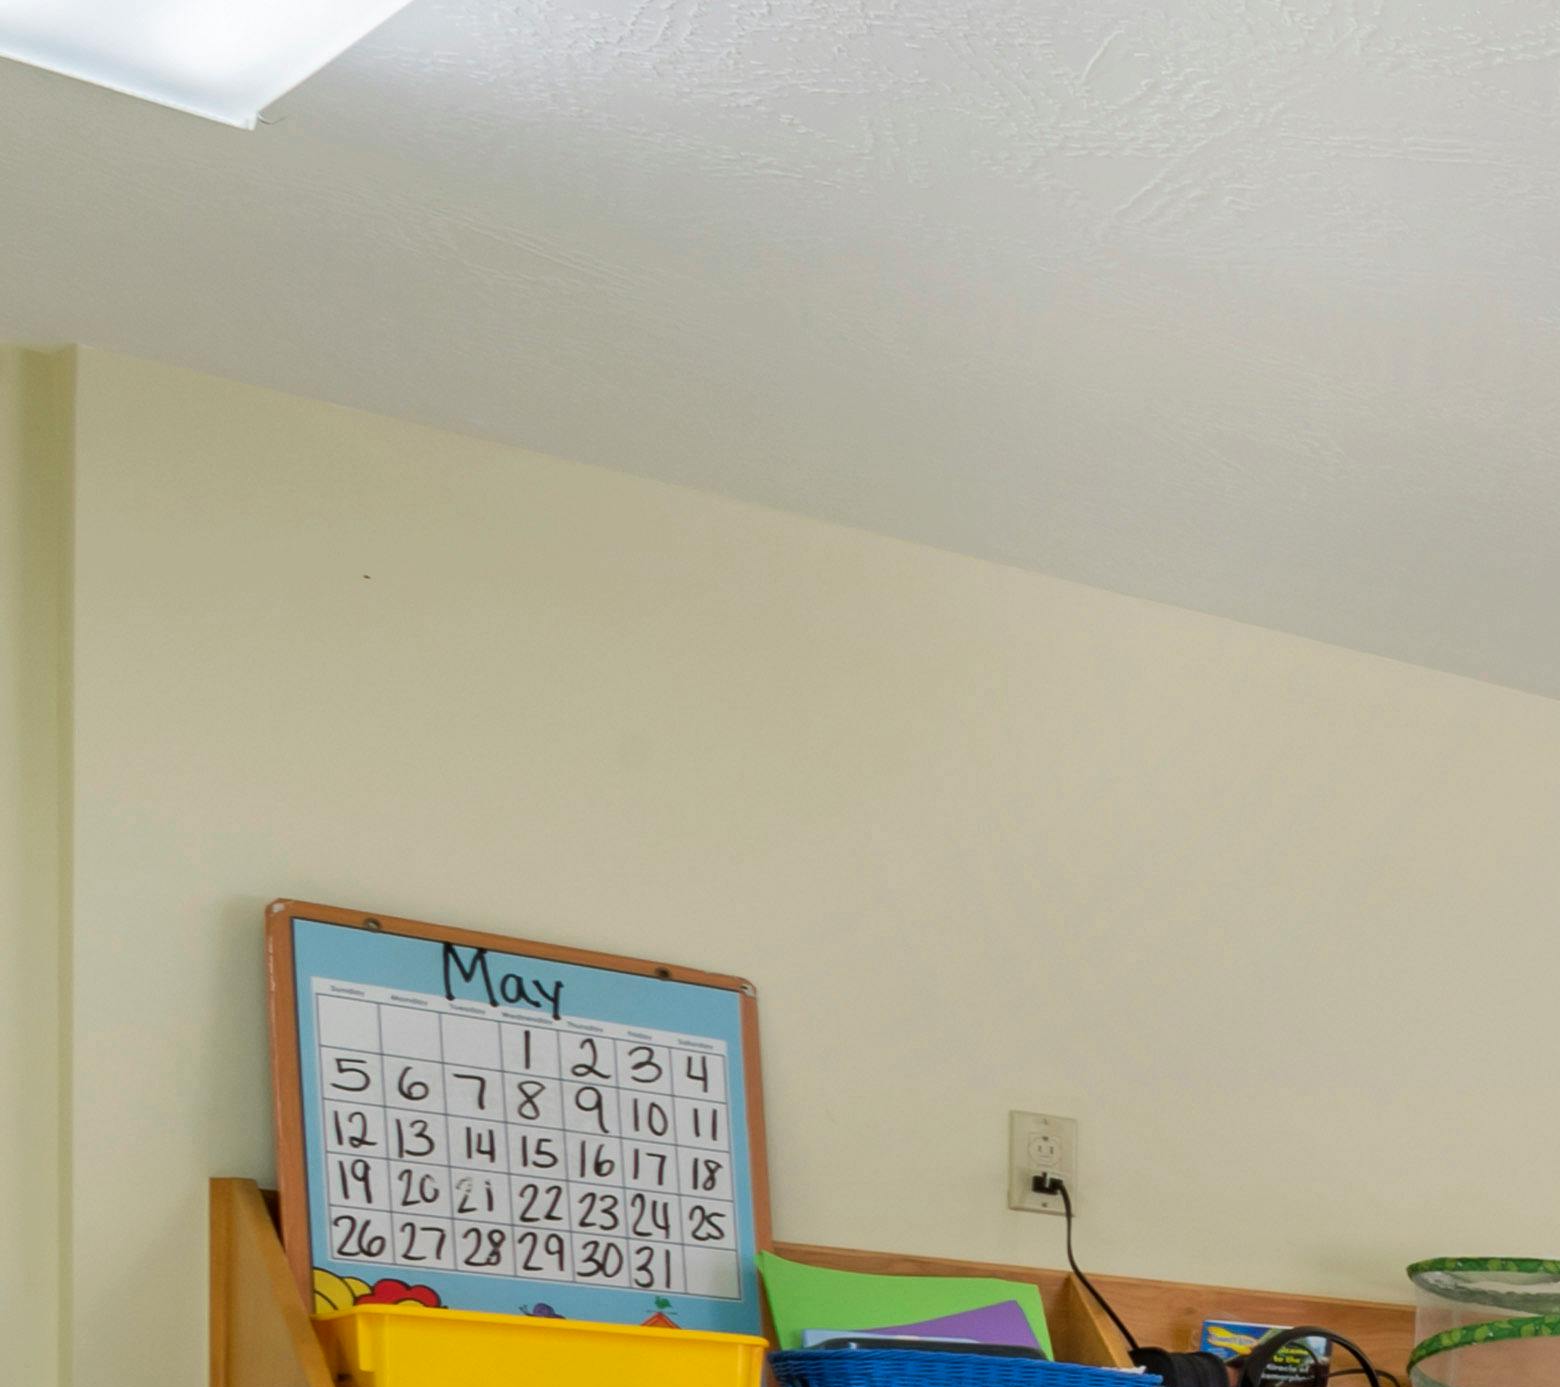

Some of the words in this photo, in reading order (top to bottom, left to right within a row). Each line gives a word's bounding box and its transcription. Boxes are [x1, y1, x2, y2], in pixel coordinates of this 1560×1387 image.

[443, 942, 563, 1020] May
[329, 1057, 372, 1093] 5
[397, 1065, 430, 1102] 6
[451, 1072, 488, 1112] 7
[516, 1079, 547, 1122] 8
[574, 1085, 611, 1135] 9
[632, 1097, 670, 1138] 10
[692, 1107, 719, 1142] 11
[523, 1029, 531, 1070] 1
[570, 1037, 612, 1080] 2
[627, 1045, 664, 1084] 3
[685, 1055, 709, 1094] 4
[333, 1109, 379, 1150] 12
[395, 1117, 436, 1160] 13
[465, 1125, 497, 1164] 14
[521, 1134, 560, 1169] 15
[579, 1139, 616, 1179] 16
[632, 1147, 668, 1187] 17
[691, 1156, 725, 1192] 18
[337, 1158, 373, 1205] 19
[397, 1167, 441, 1208] 20
[455, 1175, 495, 1215] 21
[518, 1182, 564, 1224] 22
[577, 1190, 620, 1232] 23
[629, 1191, 671, 1241] 24
[687, 1203, 727, 1242] 25
[332, 1213, 387, 1258] 26
[399, 1221, 447, 1262] 27
[461, 1226, 507, 1268] 28
[516, 1230, 565, 1273] 29
[575, 1239, 625, 1279] 30
[633, 1245, 672, 1290] 31
